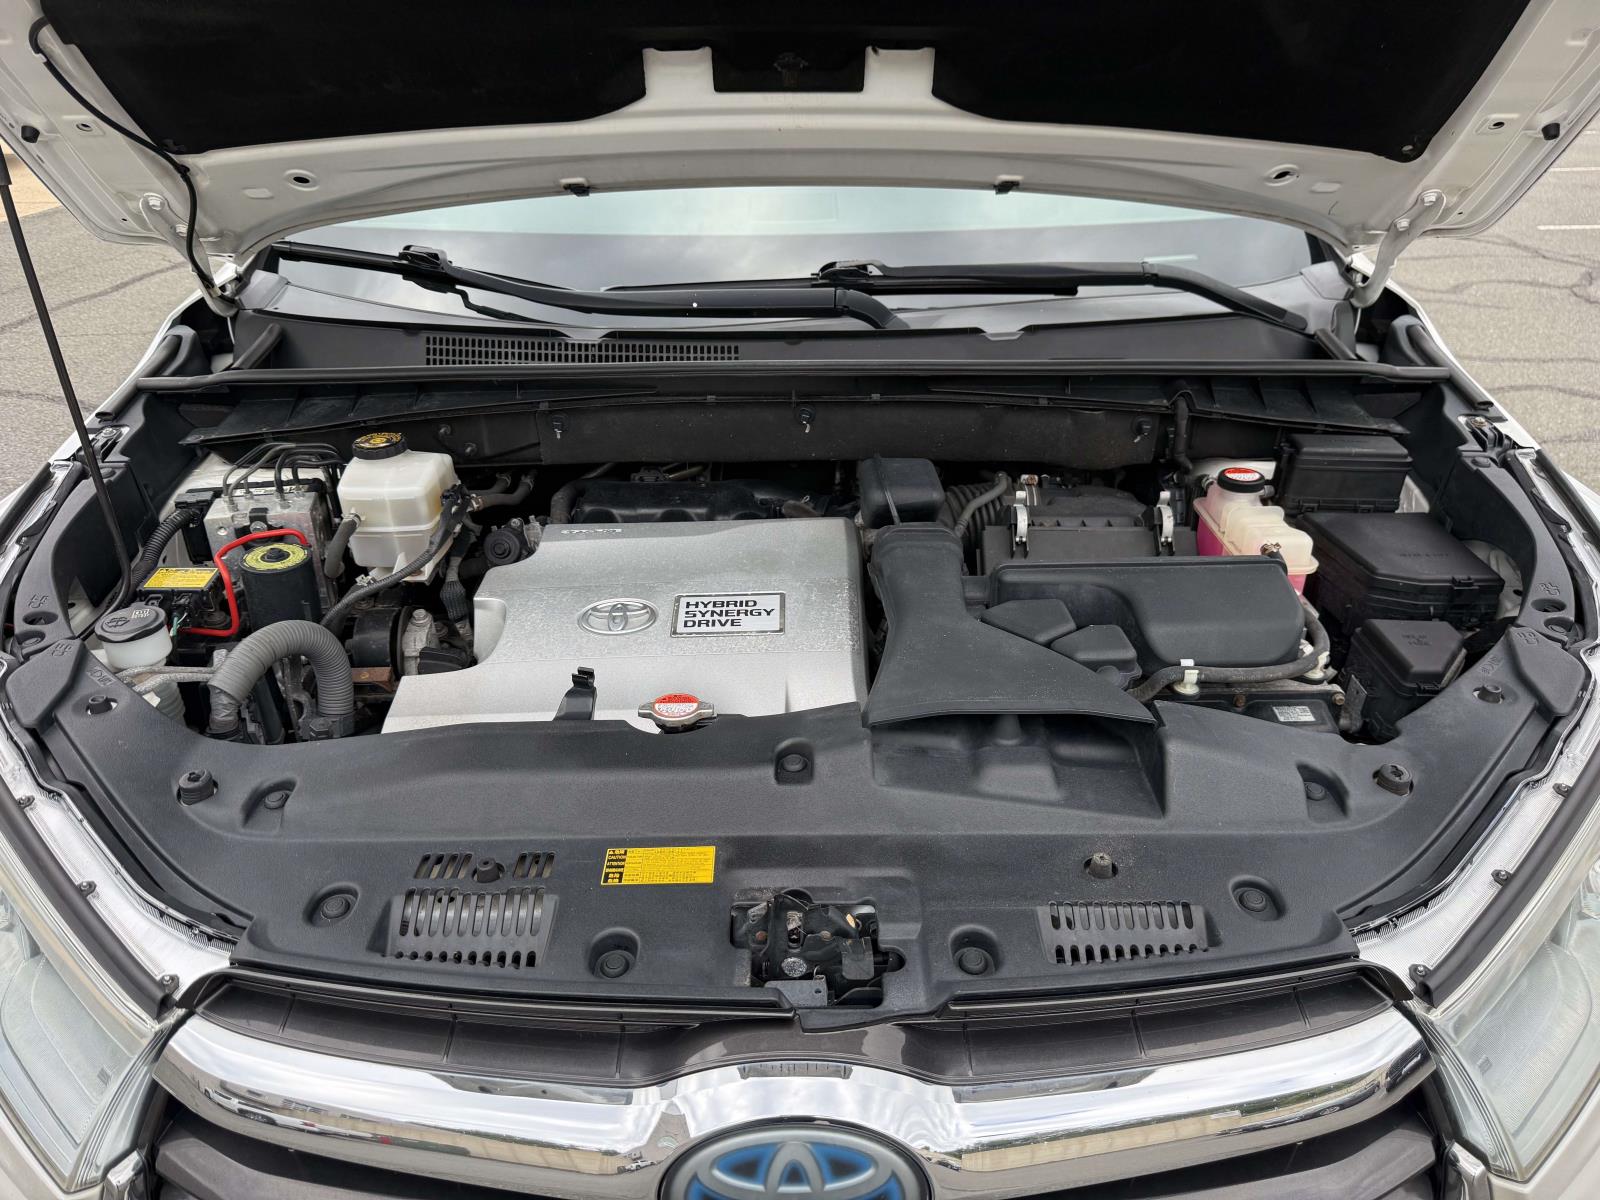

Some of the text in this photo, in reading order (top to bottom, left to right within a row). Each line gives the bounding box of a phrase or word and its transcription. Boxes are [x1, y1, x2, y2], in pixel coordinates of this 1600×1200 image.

[685, 600, 757, 608] HYBRID
[684, 608, 775, 618] SYNERGY
[683, 618, 742, 628] DRIVE
